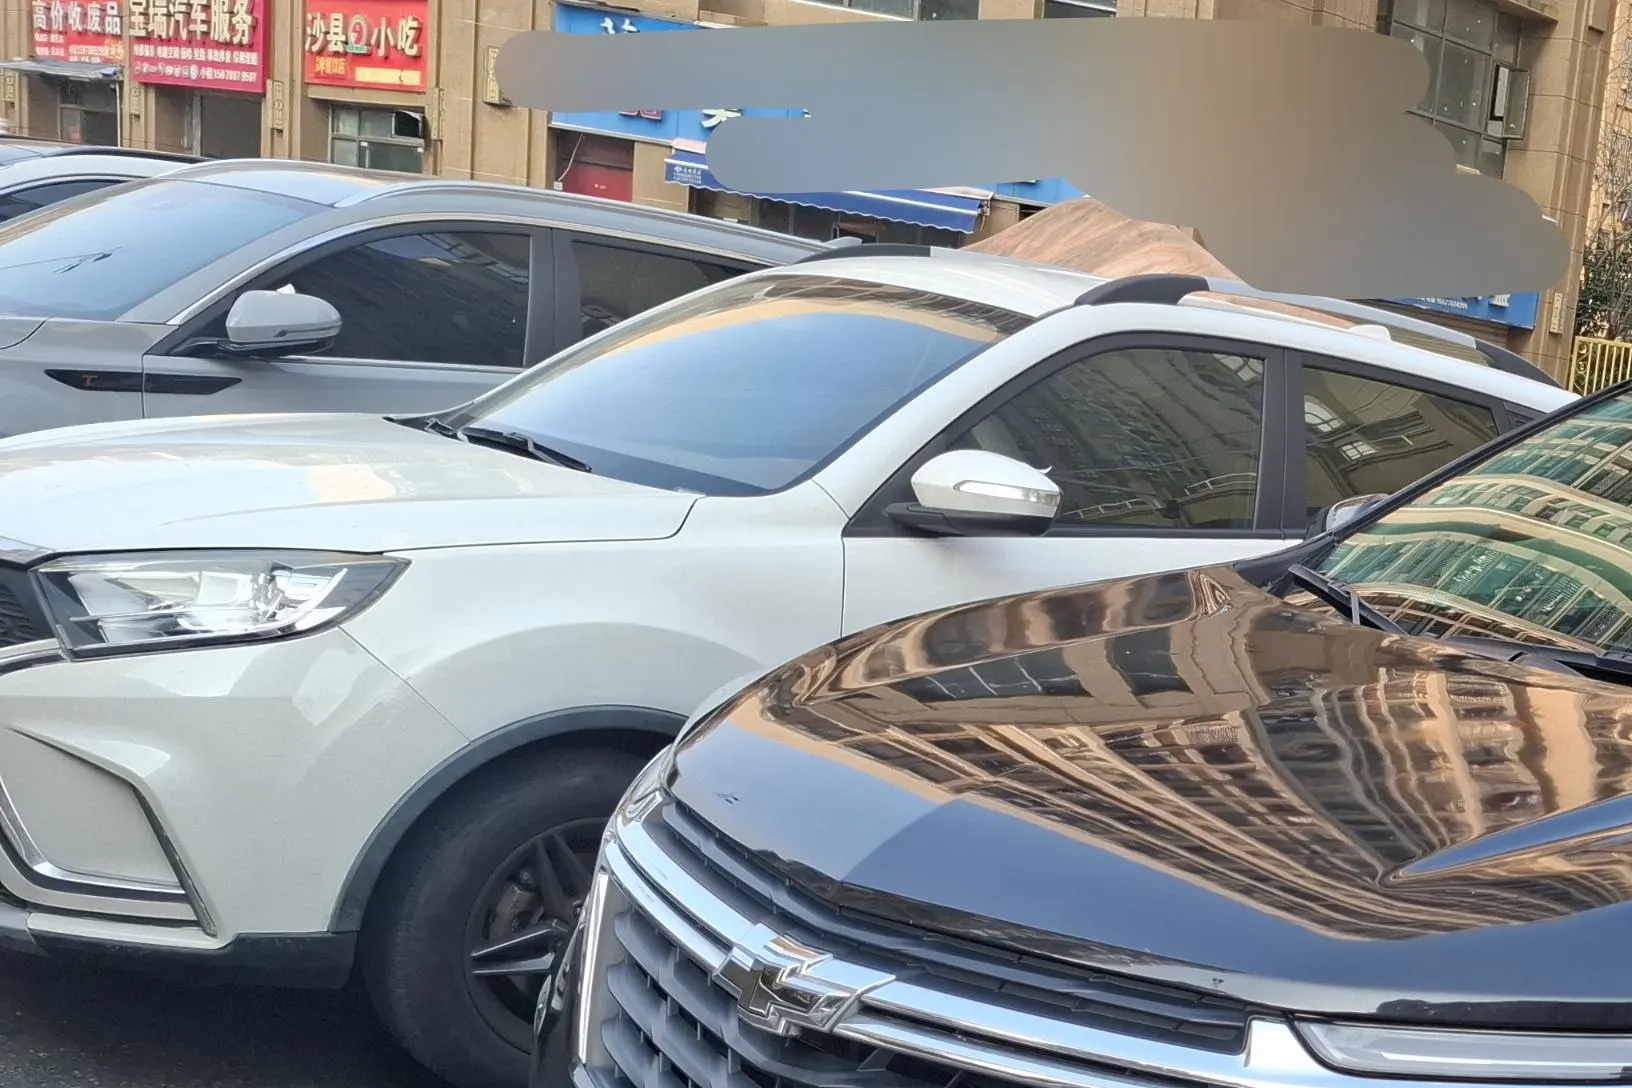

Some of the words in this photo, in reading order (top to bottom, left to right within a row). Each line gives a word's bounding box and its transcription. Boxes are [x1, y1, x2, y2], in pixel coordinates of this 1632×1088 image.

[32, 0, 121, 35] 高价收废品
[129, 0, 252, 45] 宝瑞汽车服务
